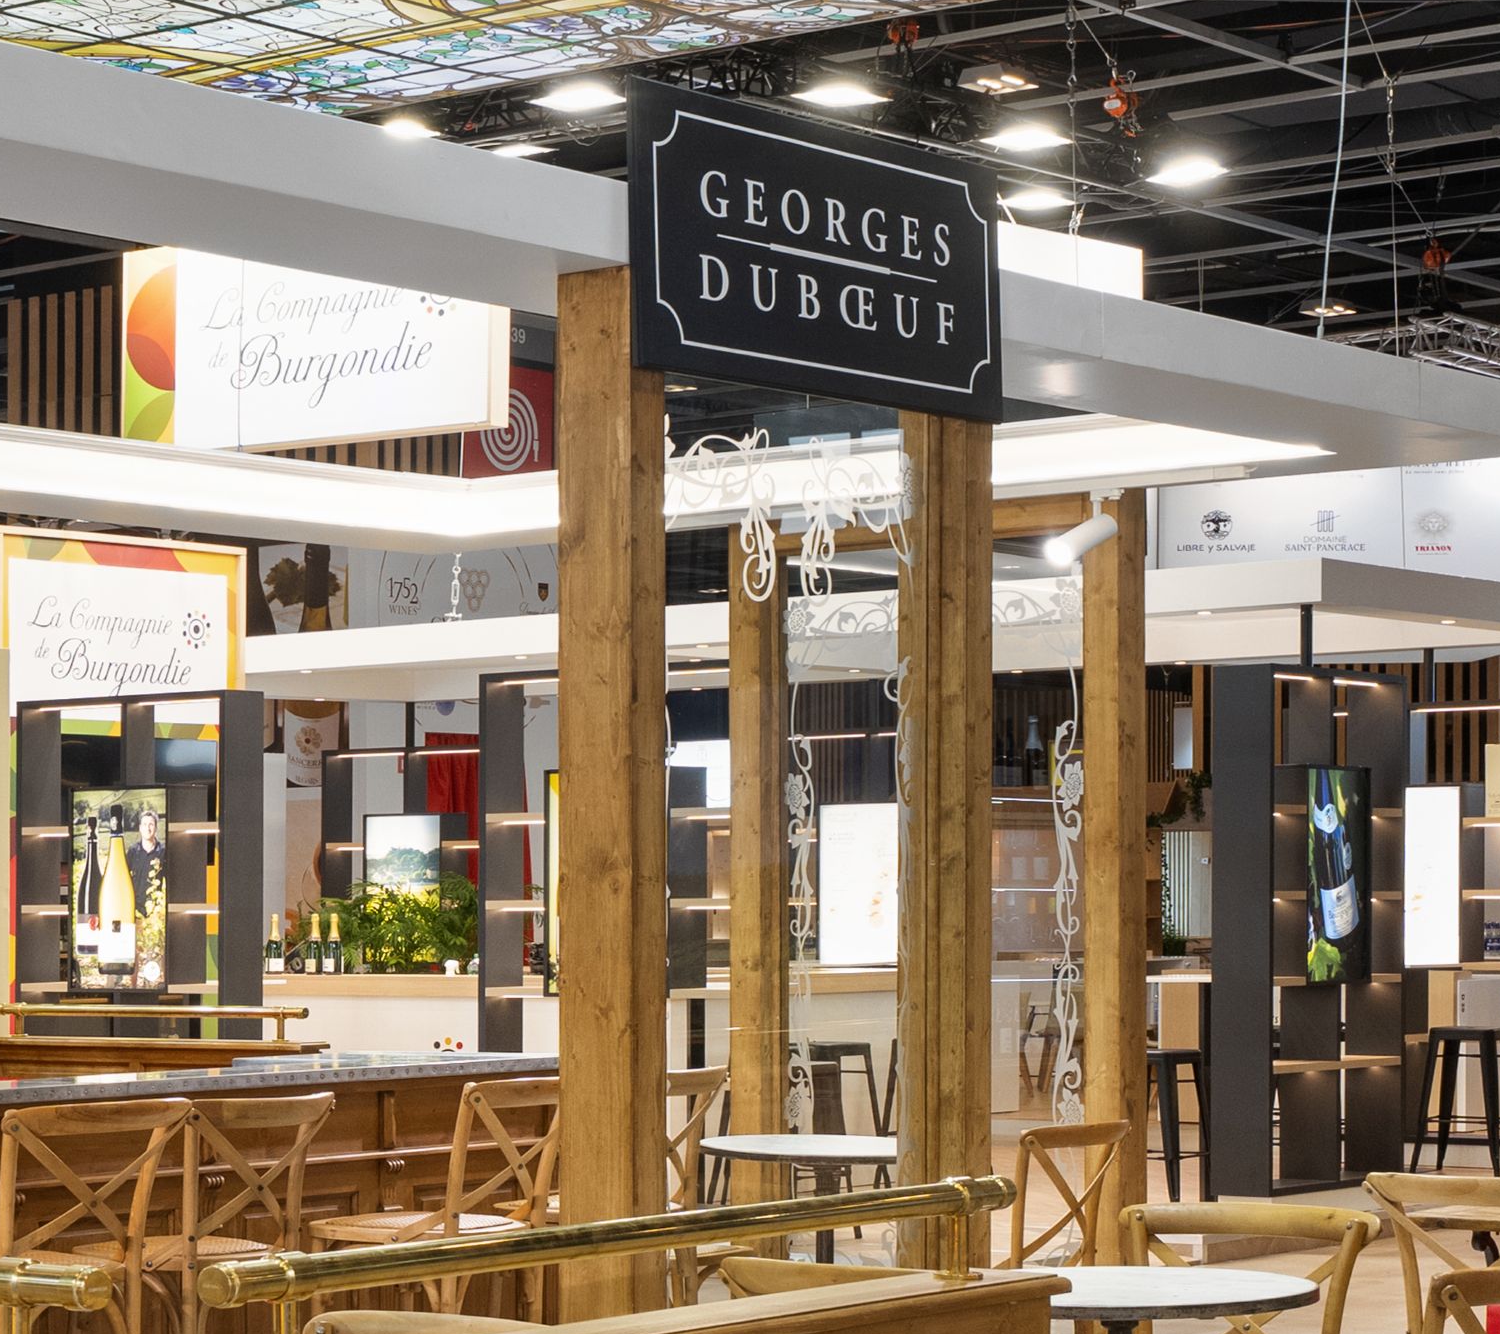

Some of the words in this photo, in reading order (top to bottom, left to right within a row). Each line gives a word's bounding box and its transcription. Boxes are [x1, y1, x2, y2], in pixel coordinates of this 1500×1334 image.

[700, 170, 951, 267] GEORGES
[200, 286, 244, 330] La
[256, 281, 406, 335] Compagnie
[699, 254, 955, 345] DUBŒUF
[207, 341, 229, 369] de
[230, 321, 433, 409] Burgondie
[1177, 544, 1204, 552] LIBRE
[1216, 543, 1256, 553] SALVAJE
[1284, 543, 1366, 552] SAINT-PANCRACE
[387, 577, 418, 604] 1752
[389, 604, 418, 616] WINES
[27, 595, 61, 629] La
[69, 598, 173, 650] Compagnie
[35, 637, 50, 659] de
[50, 637, 192, 697] Burgondie
